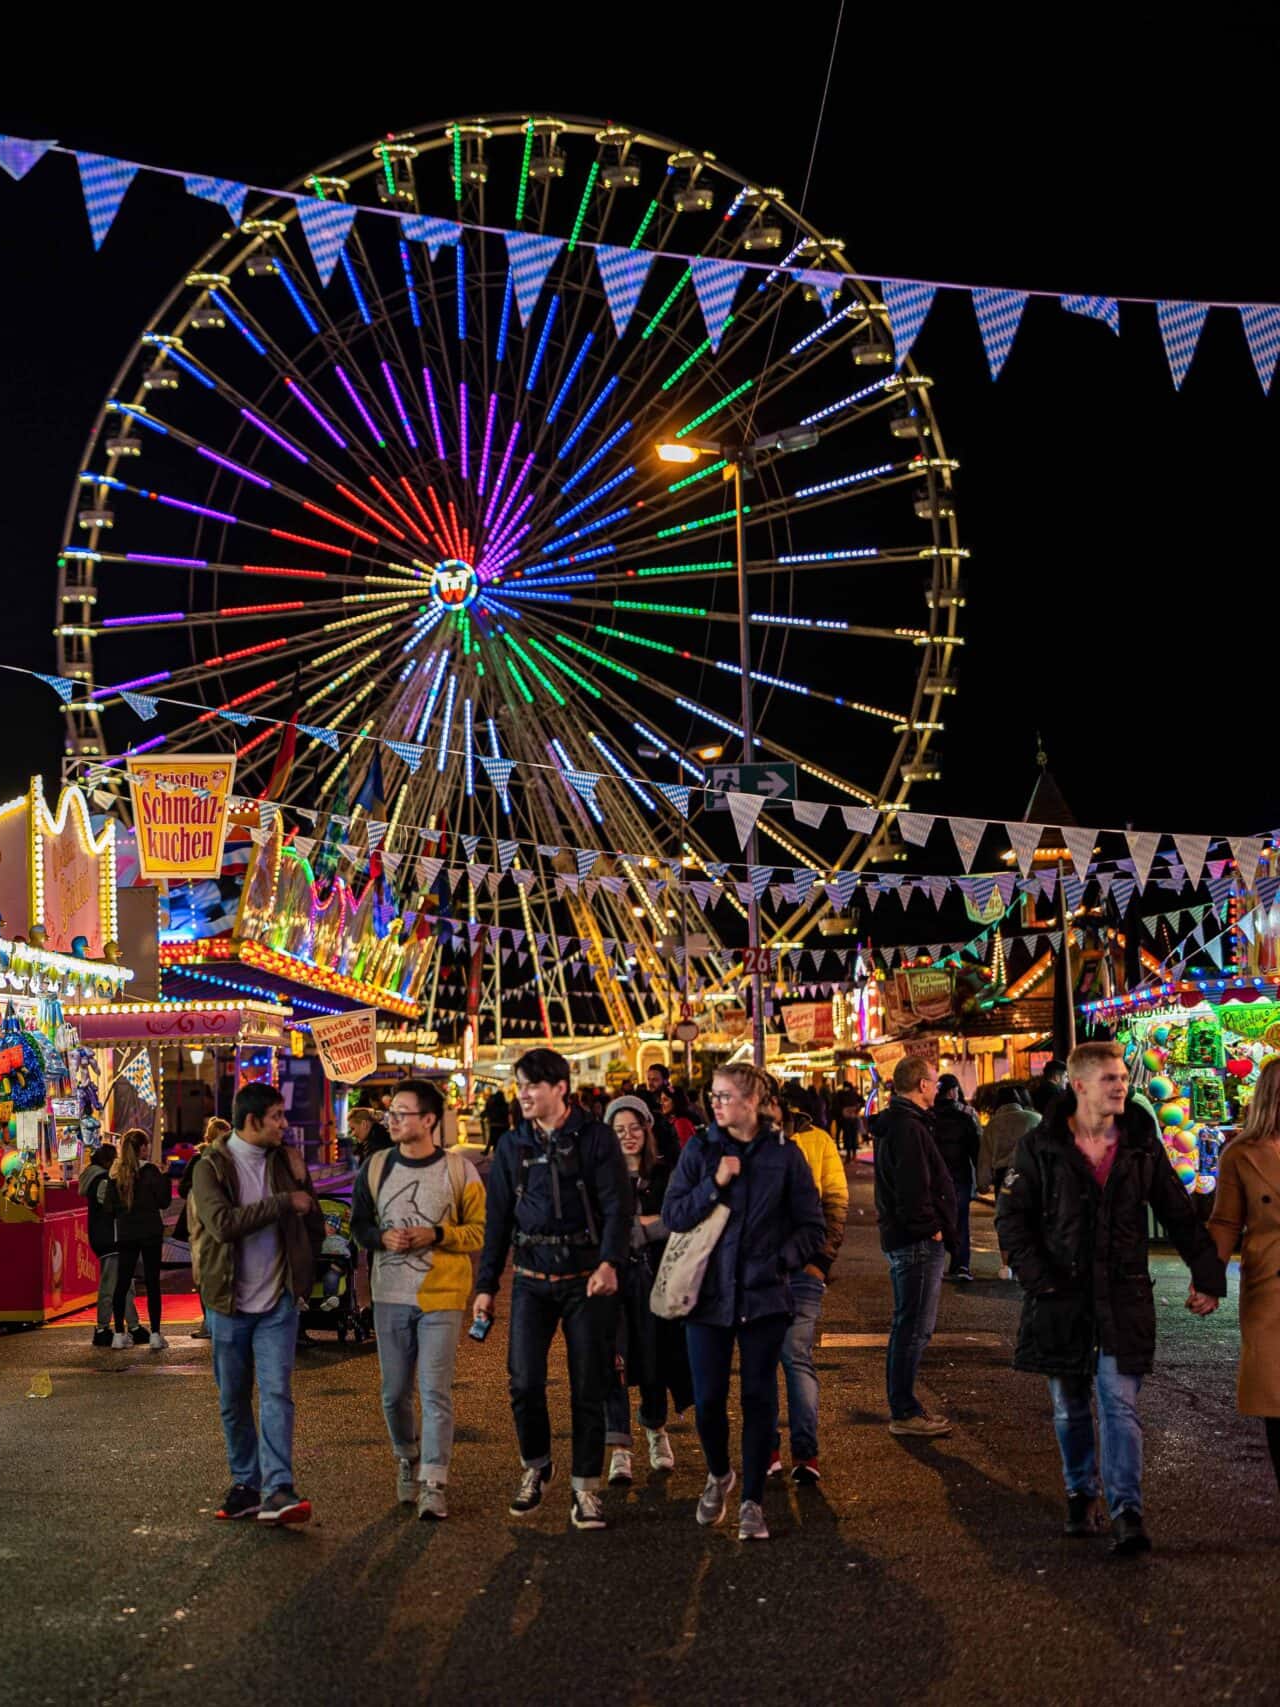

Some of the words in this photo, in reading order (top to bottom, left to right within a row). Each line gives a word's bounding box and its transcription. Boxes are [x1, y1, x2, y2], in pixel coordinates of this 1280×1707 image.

[155, 772, 209, 790] Frische
[142, 791, 223, 825] Schmalz-
[147, 827, 214, 863] kuchen
[744, 949, 769, 973] 26
[316, 1018, 353, 1039] Frische
[331, 1053, 373, 1076] kuchen
